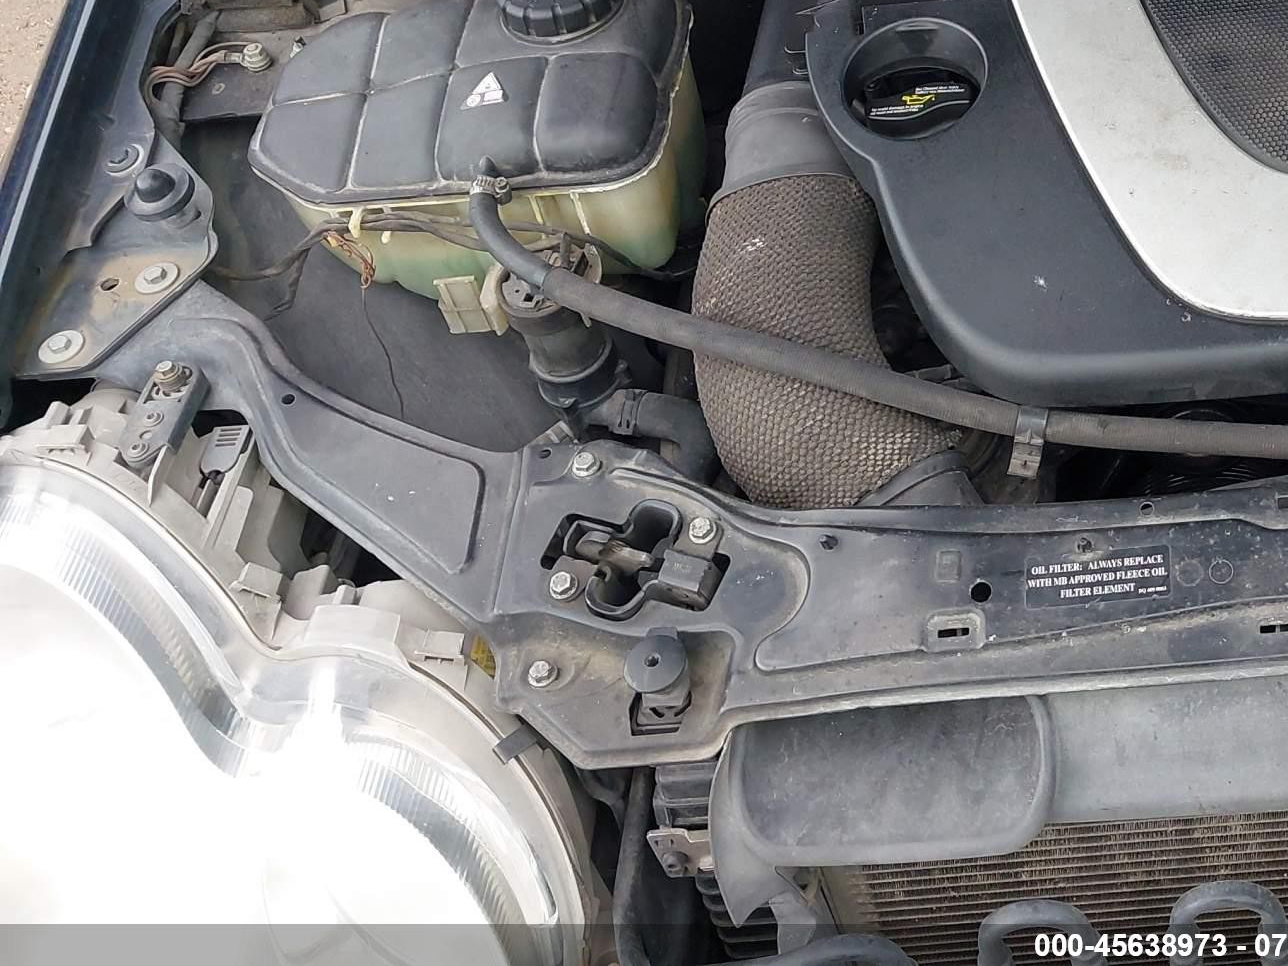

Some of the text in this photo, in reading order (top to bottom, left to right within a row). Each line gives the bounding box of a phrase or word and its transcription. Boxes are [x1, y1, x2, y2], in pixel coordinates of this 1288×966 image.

[1031, 554, 1164, 575] OIL FILTER: ALWAYS REPLACE
[1028, 567, 1168, 588] WITH MB APPROVED FLEECE OIL
[1060, 587, 1092, 599] FILTER
[1093, 582, 1137, 596] ELEMENT
